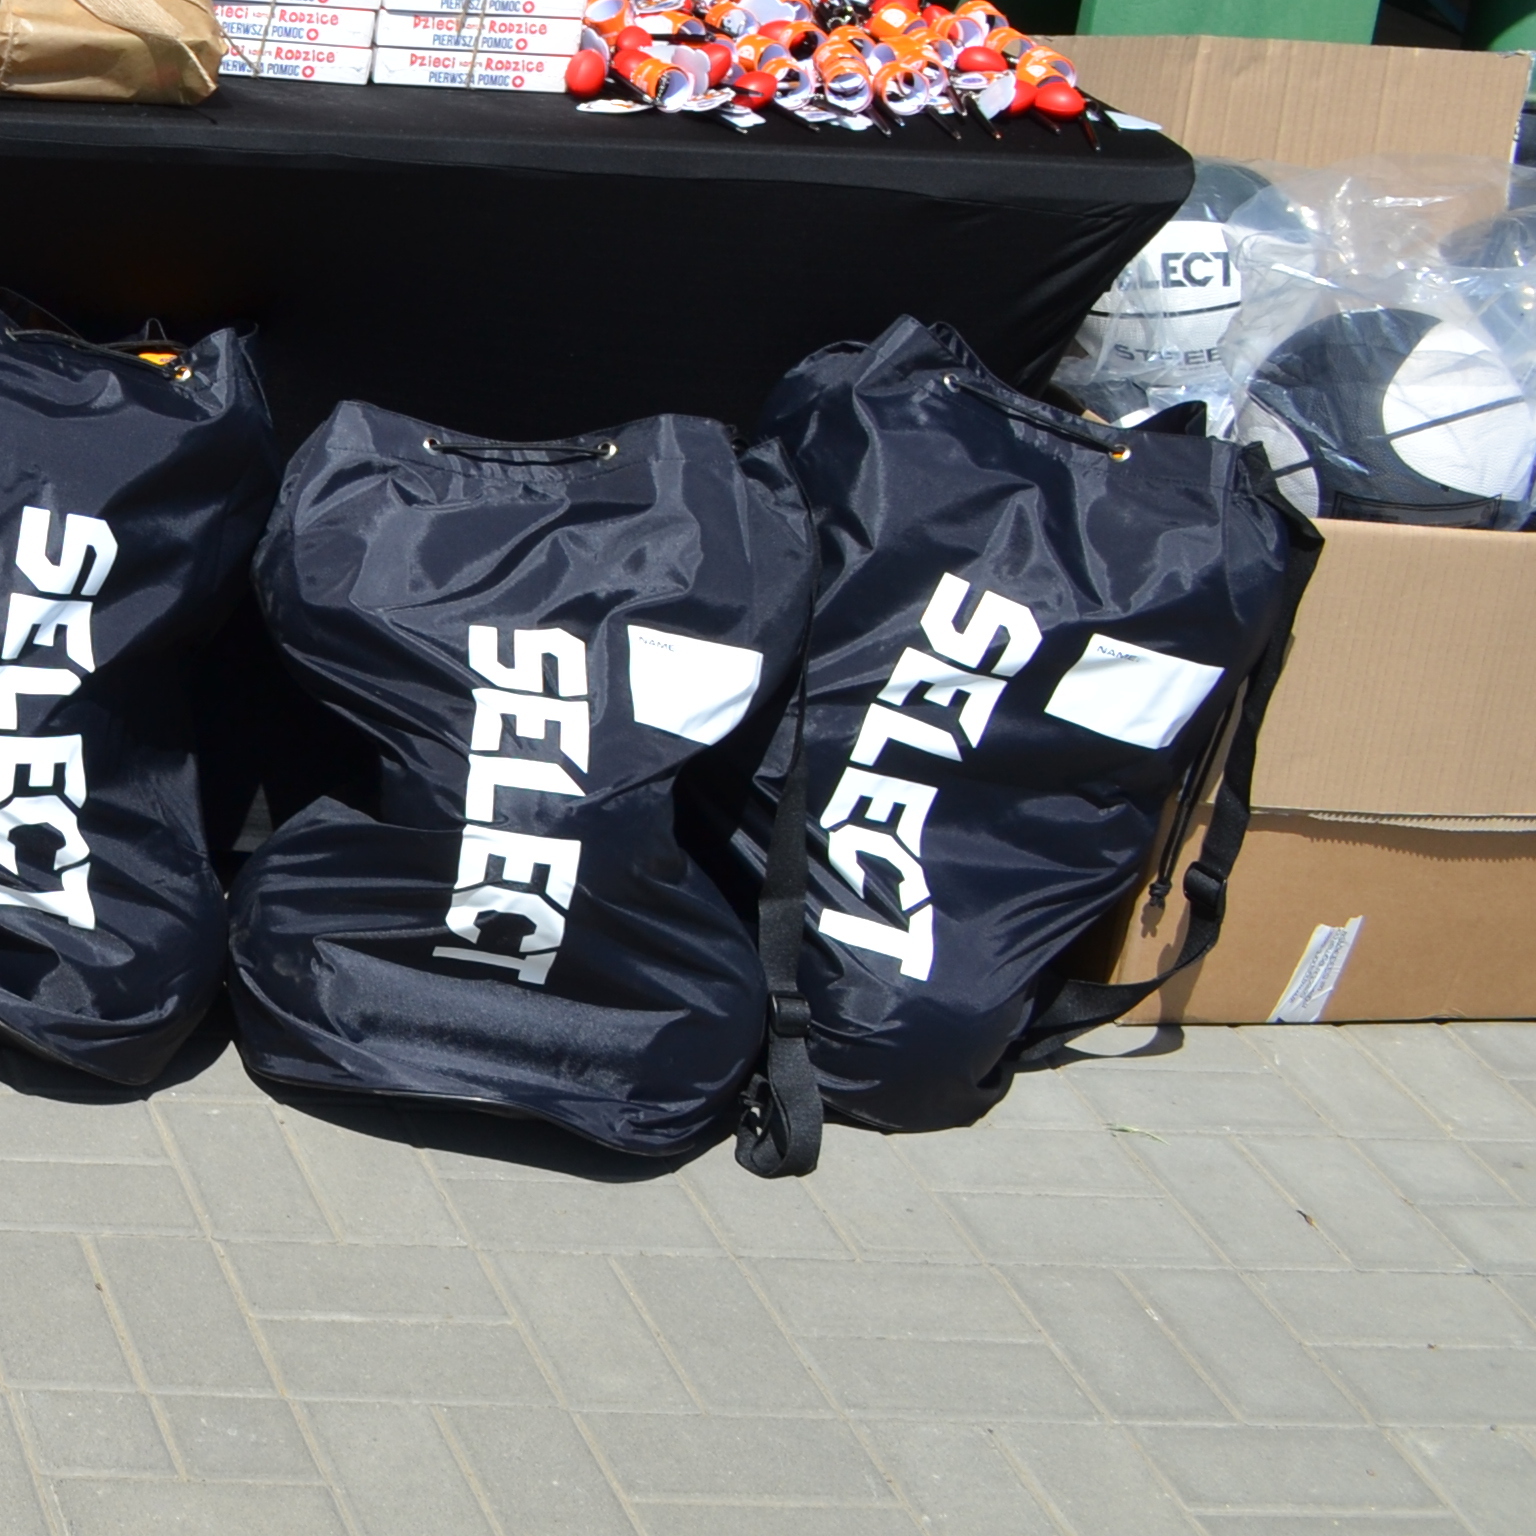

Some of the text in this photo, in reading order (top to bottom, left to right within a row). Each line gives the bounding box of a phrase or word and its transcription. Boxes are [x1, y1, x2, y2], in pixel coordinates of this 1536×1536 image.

[488, 0, 521, 13] POMOC
[222, 22, 304, 40] PIERWSZ POMOC
[433, 33, 514, 50] PIERWSZ POMOC
[267, 62, 301, 77] POMOC
[477, 74, 511, 87] POMOC
[1118, 251, 1231, 289] LECT
[818, 571, 1044, 982] SELECT
[432, 624, 591, 986] SELECT
